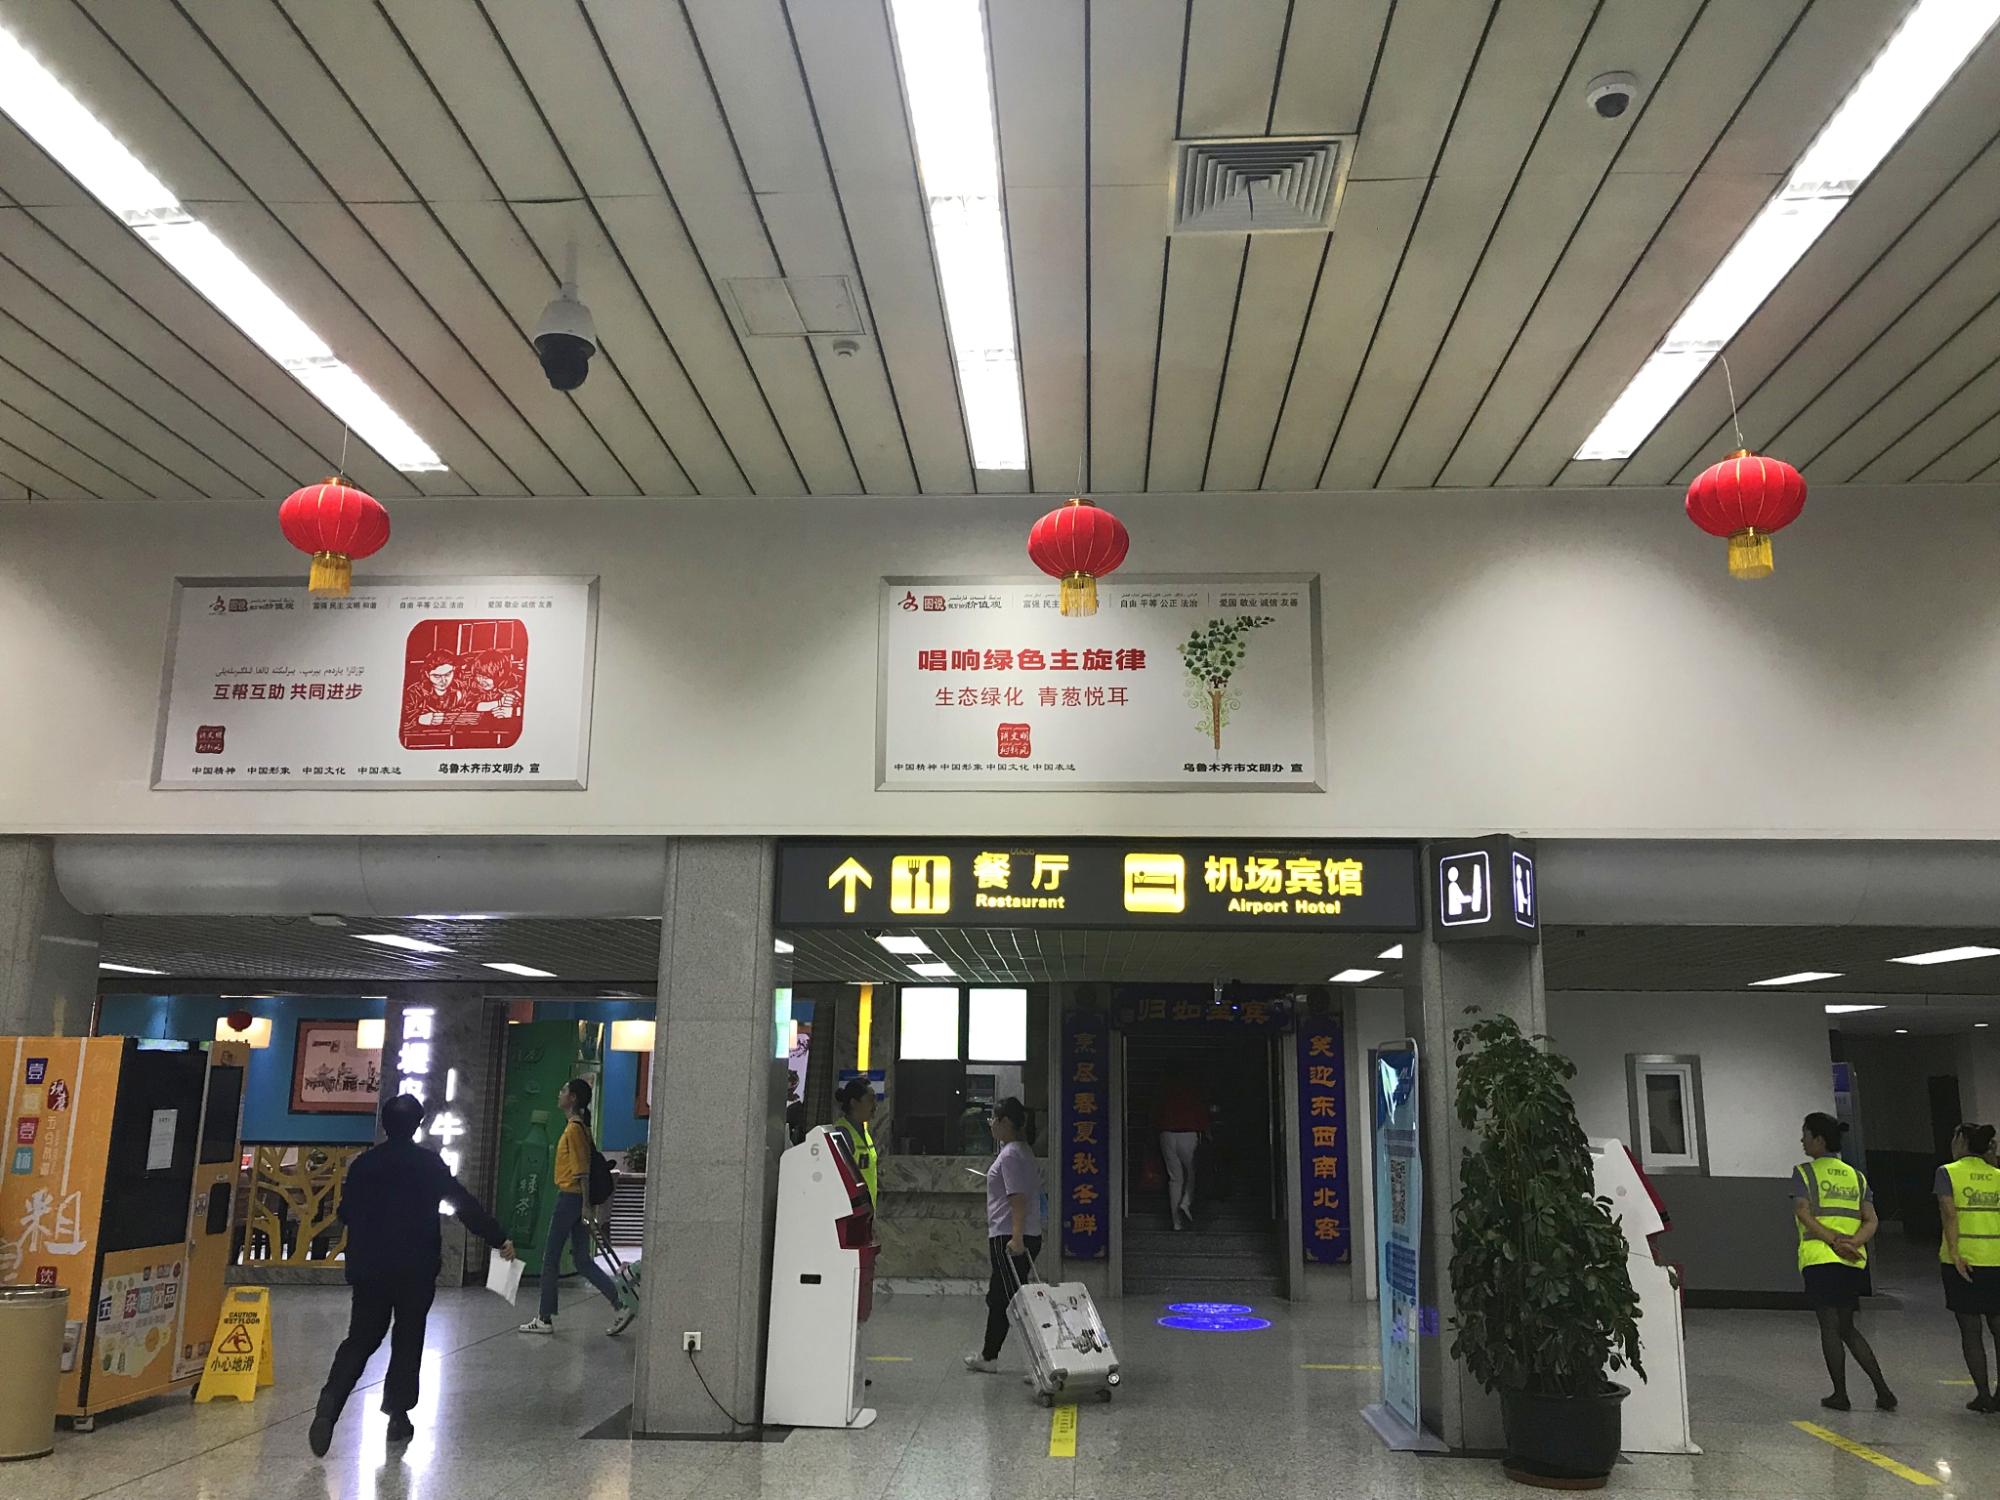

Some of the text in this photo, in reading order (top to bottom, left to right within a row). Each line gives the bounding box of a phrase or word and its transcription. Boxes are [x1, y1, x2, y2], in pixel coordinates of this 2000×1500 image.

[1023, 599, 1040, 609] 富强
[1043, 599, 1060, 609] 民主
[1120, 599, 1198, 608] 自由 平等 公正 法治
[1219, 599, 1298, 608] 爱国 敬业 诚信 友善
[918, 648, 1146, 671] 唱响绿色主旋律
[213, 683, 363, 700] 互帮互助 共同进步
[935, 686, 1129, 707] 生态绿化 青葱悦耳
[191, 766, 402, 775] 中国精神 中国形象 中国文化 中国表达
[438, 763, 540, 774] 乌鲁木齐市文明办 宣
[893, 763, 1076, 771] 中国精神 中国形象 中国文化 中国表达
[1183, 763, 1303, 773] 乌鲁木齐市文明办 宣
[973, 852, 1070, 890] 餐厅
[1204, 855, 1363, 896] 机场宾馆
[976, 893, 1065, 909] Restaurant
[1228, 898, 1341, 915] Airport Hotel
[1309, 1035, 1340, 1240] 笑迎东西南北客
[811, 1143, 820, 1156] 6
[211, 1355, 255, 1372] 小心地滑
